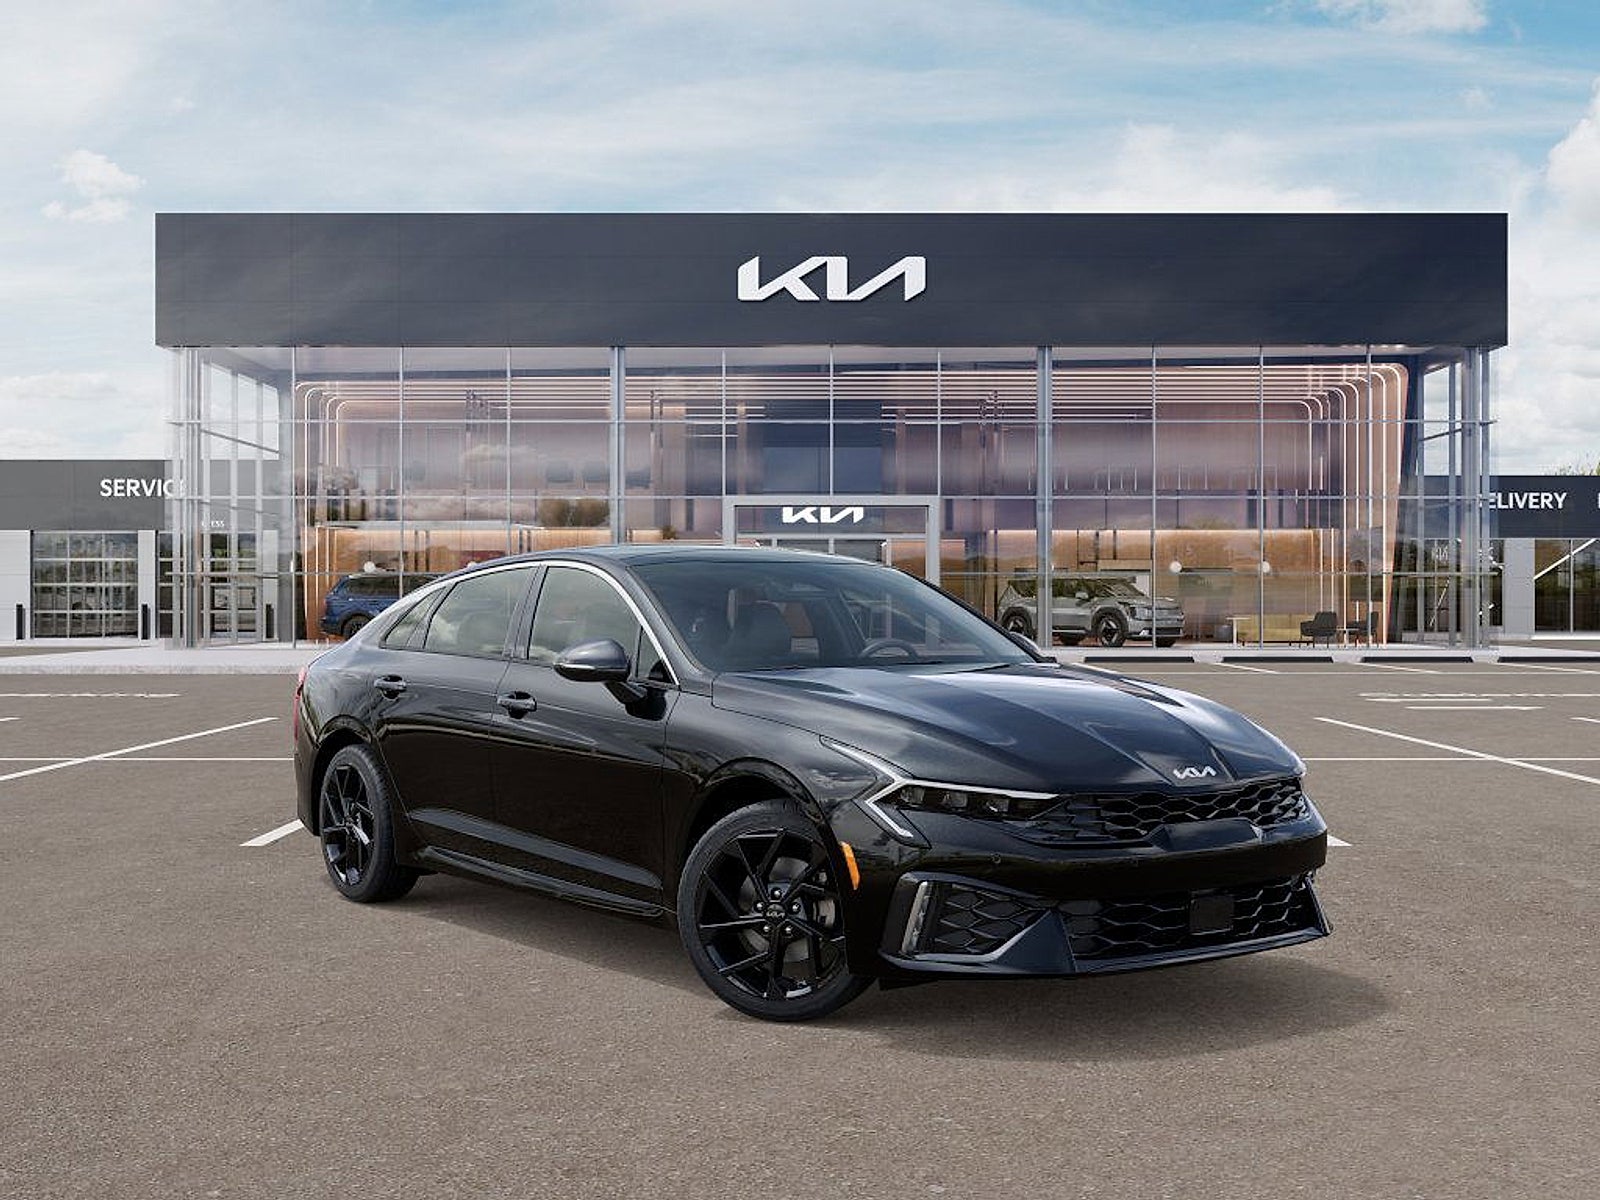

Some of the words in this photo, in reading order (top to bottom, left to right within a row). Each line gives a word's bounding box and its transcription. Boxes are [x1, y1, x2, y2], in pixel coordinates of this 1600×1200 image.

[737, 255, 927, 301] KIA
[1479, 491, 1567, 510] ELIVERY
[781, 506, 864, 524] KIA
[1172, 765, 1217, 780] KIA
